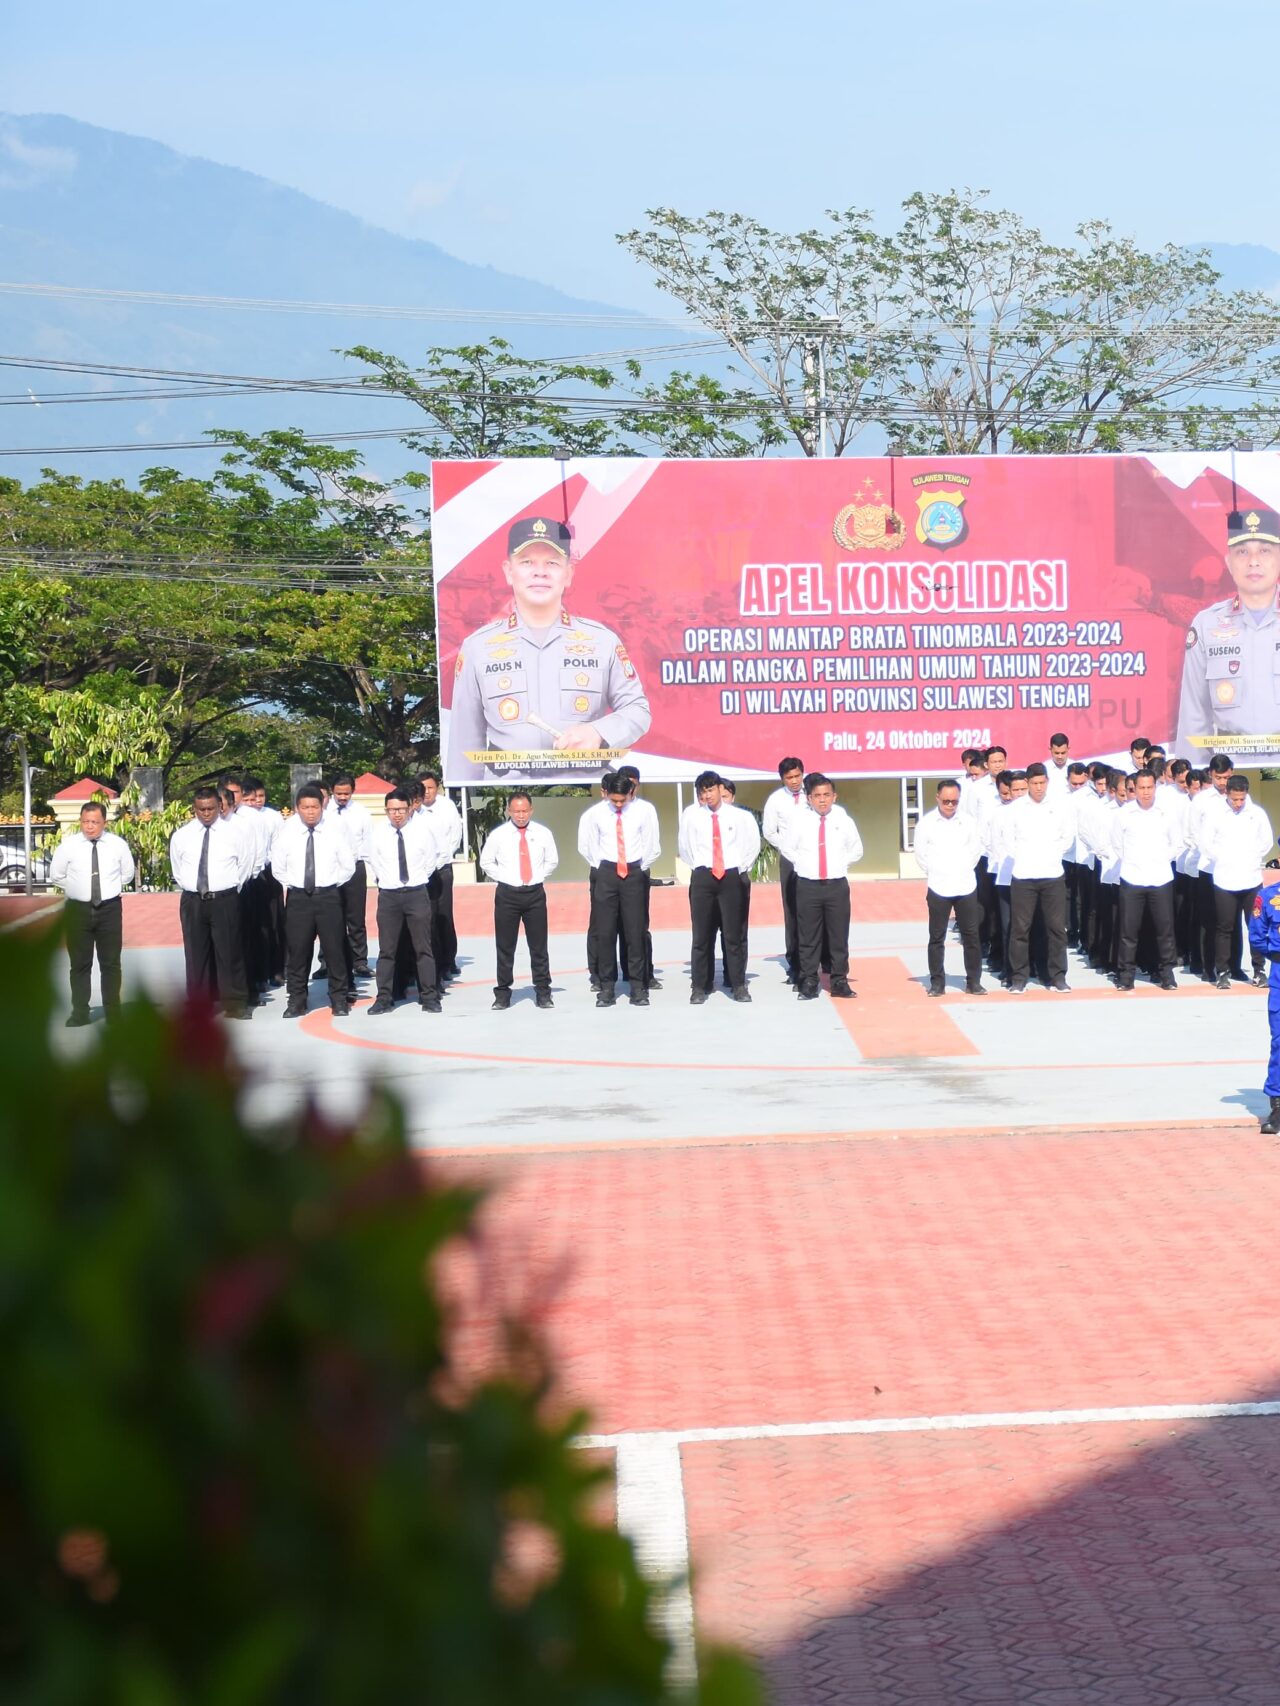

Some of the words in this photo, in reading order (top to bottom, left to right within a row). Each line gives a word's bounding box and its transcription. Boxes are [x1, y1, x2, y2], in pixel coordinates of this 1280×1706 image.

[912, 474, 944, 486] SULAWESI
[945, 474, 970, 486] TENGAH
[740, 563, 832, 616] APEL
[837, 560, 1068, 615] KONSOLIDASI
[685, 628, 762, 652] OPERASI
[768, 626, 844, 651] MANTAP
[850, 625, 906, 650] BRATA
[912, 623, 1018, 649] TINOMBALA
[1022, 621, 1122, 647] 2023-2024
[1208, 646, 1241, 656] SUSENO
[485, 662, 512, 673] AGUS
[515, 661, 522, 670] N
[563, 658, 599, 668] POLRI
[662, 660, 726, 684] DALAM
[733, 658, 807, 683] RANGKA
[813, 656, 913, 681] PEMILIHAN
[919, 655, 976, 680] UMUM
[981, 654, 1041, 678] TAHUN
[1046, 652, 1146, 677] 2023-2024
[721, 691, 740, 714] DI
[745, 689, 826, 713] WILAYAH
[832, 687, 917, 712] PROVINSI
[923, 685, 1014, 710] SULAWESI
[1019, 684, 1090, 708] TENGAH
[1074, 698, 1141, 729] KPU
[824, 732, 862, 752] Palu,
[866, 731, 885, 750] 24
[889, 730, 949, 749] Oktober
[953, 729, 991, 748] 2024
[1213, 746, 1255, 754] WAKAPOLDA
[494, 762, 530, 770] KAPOLDA
[531, 761, 569, 769] SULAWESI
[571, 760, 602, 768] TENGAH
